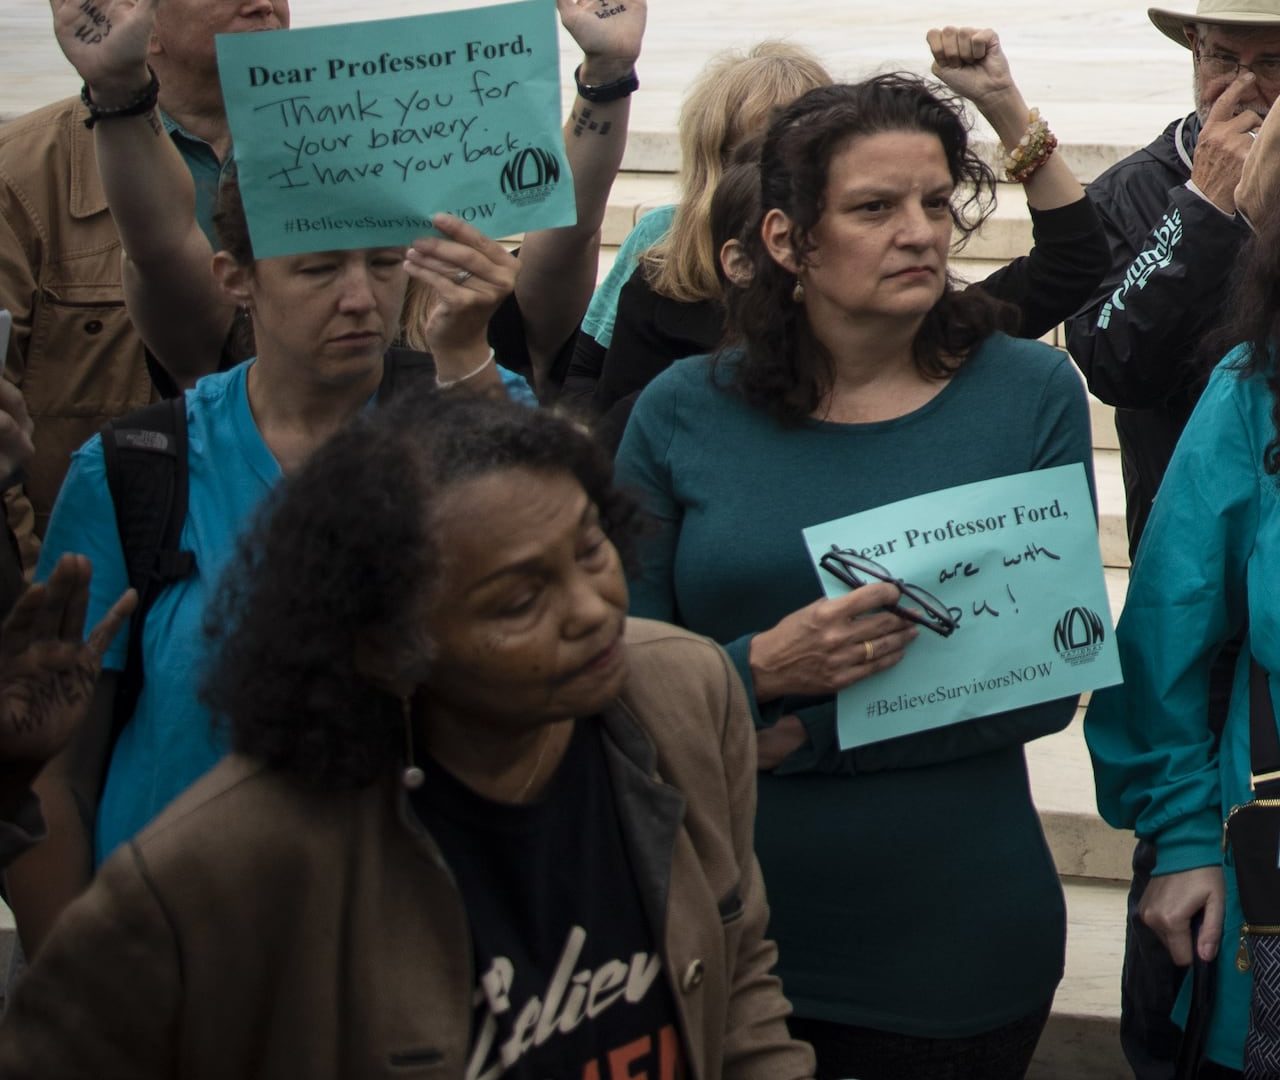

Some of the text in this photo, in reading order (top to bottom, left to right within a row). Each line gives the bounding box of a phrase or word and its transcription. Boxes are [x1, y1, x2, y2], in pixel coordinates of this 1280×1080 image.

[249, 34, 533, 88] Dear Professor Ford,
[253, 89, 383, 128] Thank
[471, 69, 520, 107] for
[268, 164, 310, 190] I
[317, 161, 385, 185] have
[500, 147, 561, 194] NOW
[283, 202, 498, 234] #BelieveSurvivoOW
[903, 512, 1008, 550] Professor
[1012, 498, 1069, 526] Ford,
[938, 561, 981, 584] are
[1053, 605, 1105, 654] NOW
[865, 661, 1054, 720] #BelieveSurvivorsNOW
